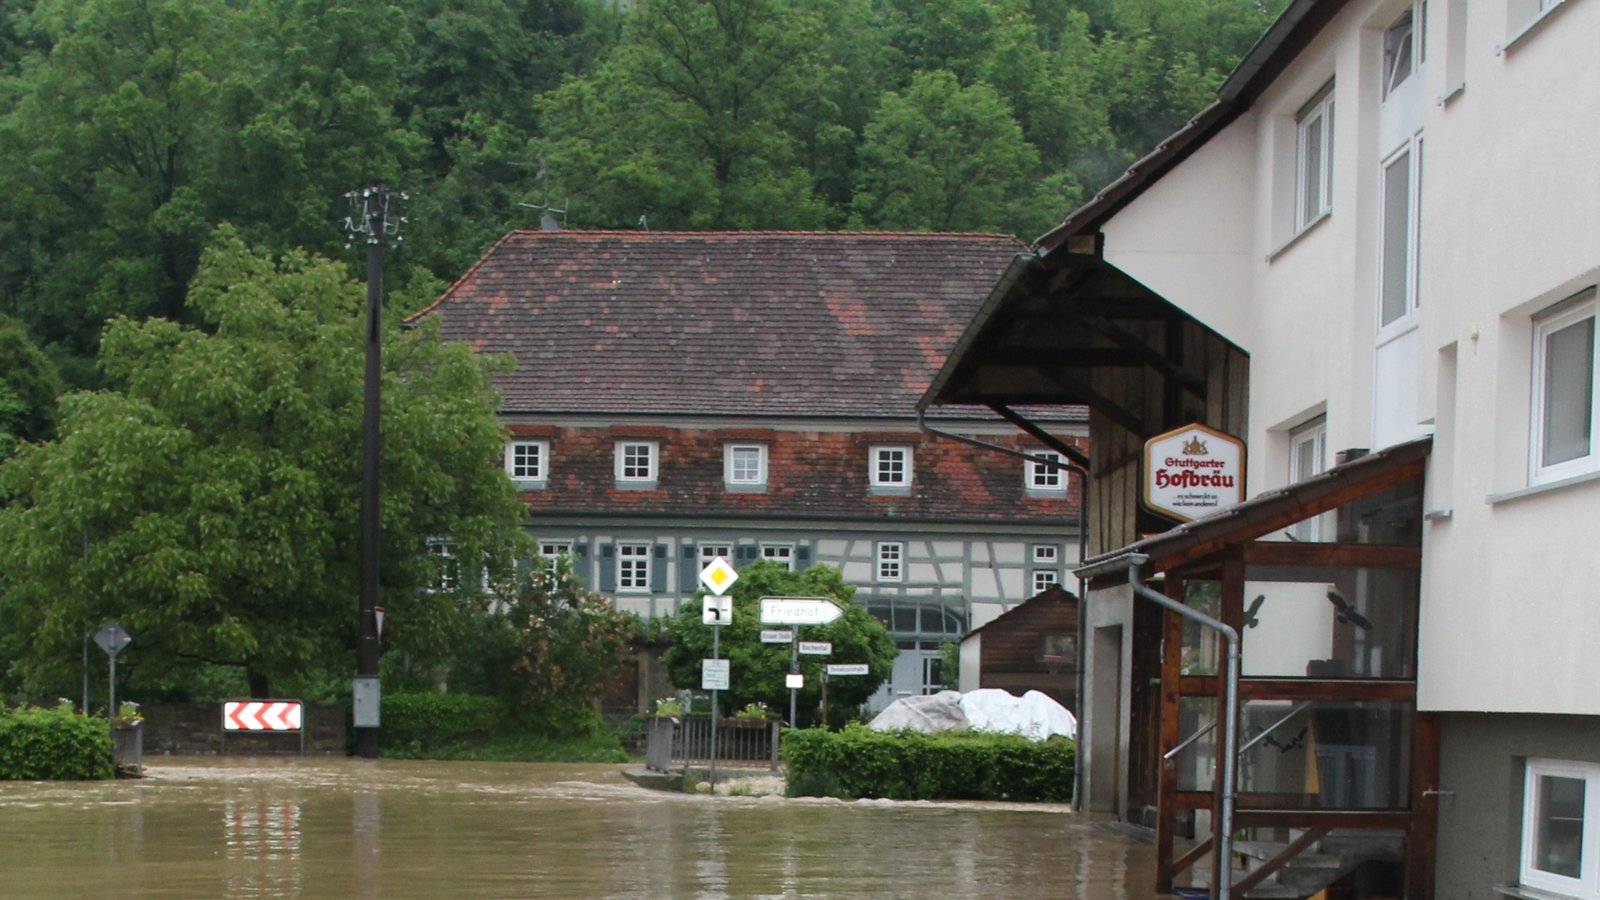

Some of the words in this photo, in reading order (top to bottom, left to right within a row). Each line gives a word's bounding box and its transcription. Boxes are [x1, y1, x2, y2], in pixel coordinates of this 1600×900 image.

[1164, 457, 1225, 469] Stuttgarter
[1155, 468, 1234, 489] Hofbräu
[770, 605, 819, 617] Friedhof
